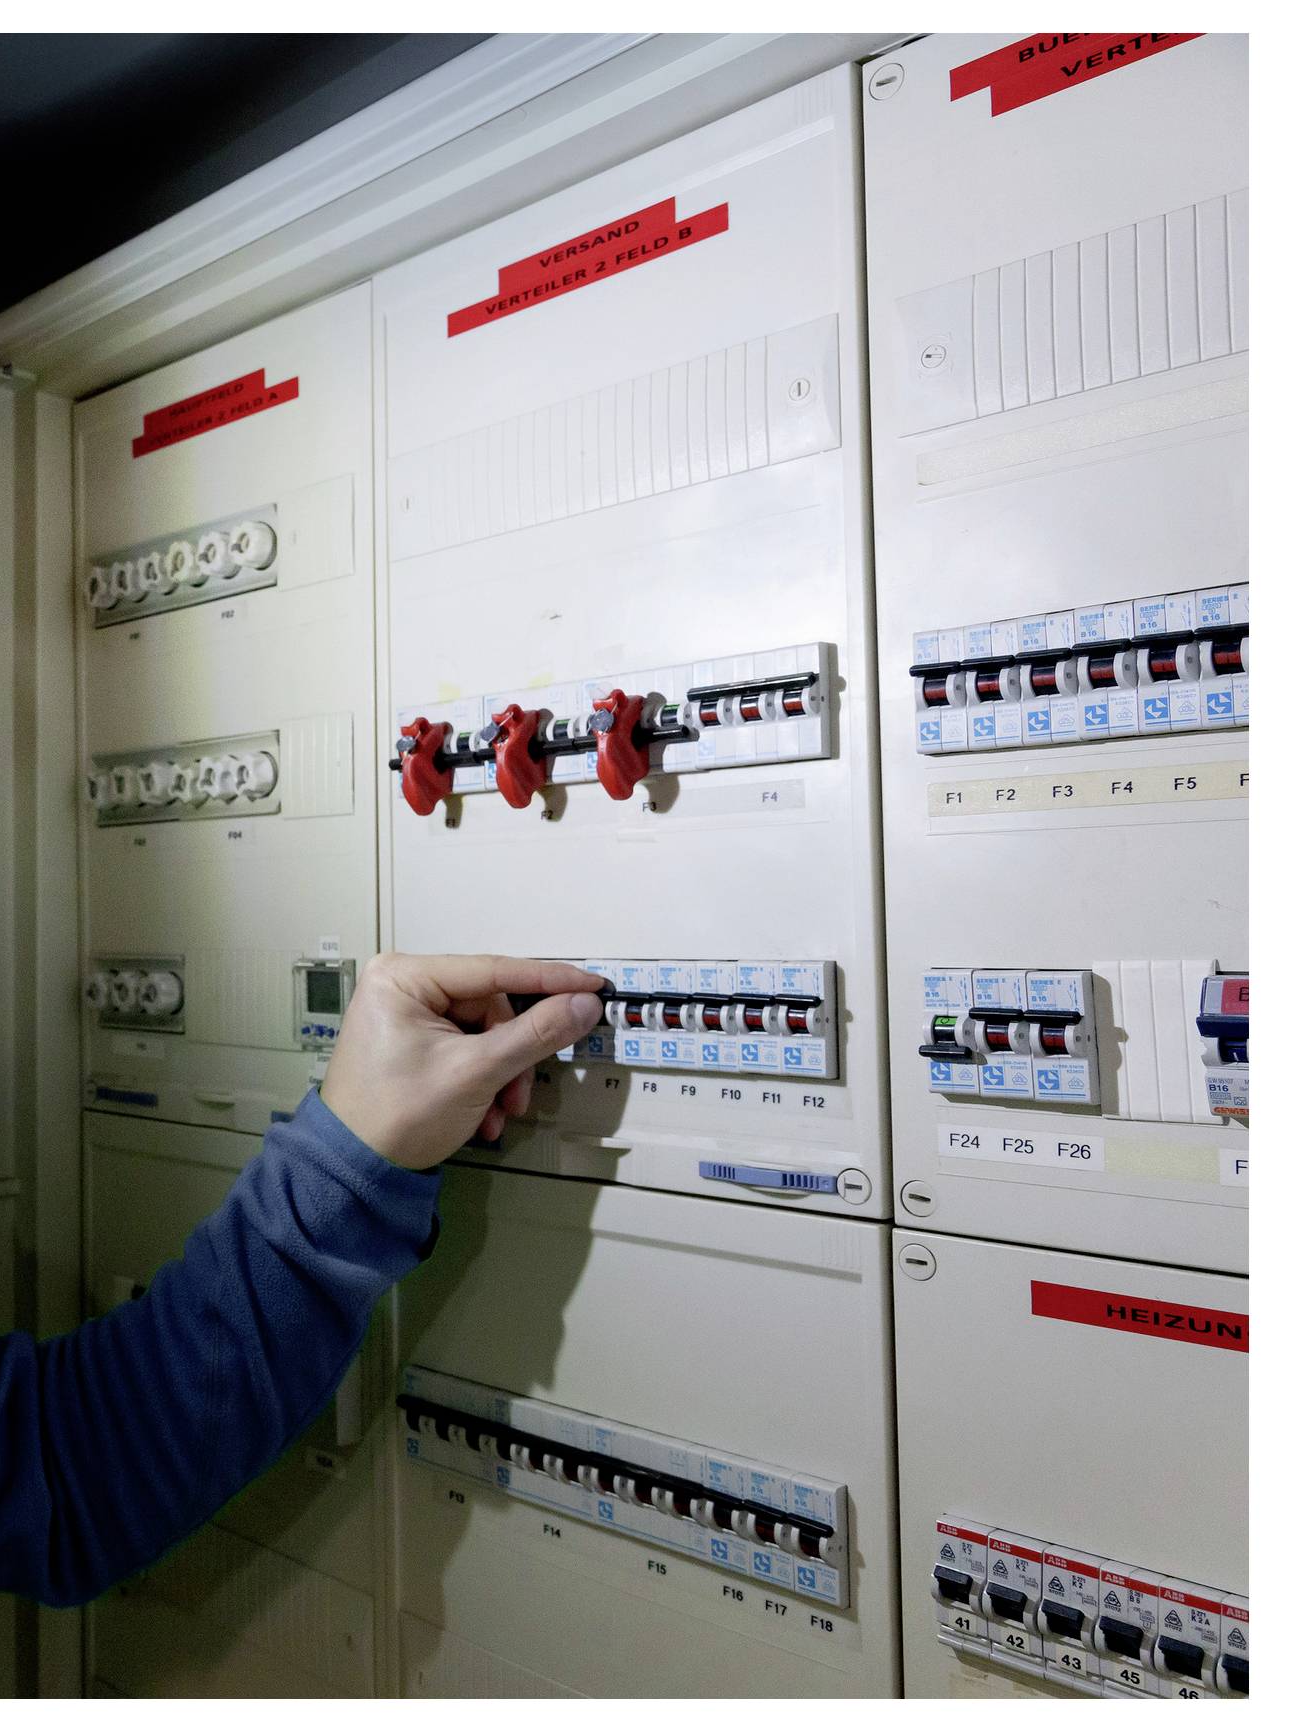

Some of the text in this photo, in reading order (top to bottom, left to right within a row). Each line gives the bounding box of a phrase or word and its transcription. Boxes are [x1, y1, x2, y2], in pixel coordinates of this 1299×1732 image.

[1019, 33, 1091, 63] BUE
[1061, 33, 1180, 77] VERTE
[539, 221, 640, 268] VERSAND
[485, 226, 693, 315] VERTEILER 2 FELD B
[762, 791, 778, 803] F4
[946, 792, 962, 804] F1
[996, 788, 1016, 801] F2
[1052, 785, 1073, 798] F3
[1111, 781, 1134, 794] F4
[1174, 776, 1197, 790] F5
[642, 801, 657, 812] F3
[605, 1078, 825, 1108] F7 F8 F9 F10 F11 F12
[949, 1133, 1091, 1160] F24 F25 F26
[1235, 1159, 1249, 1175] F
[1107, 1304, 1249, 1340] HEIZUN
[449, 1490, 465, 1504] F13
[543, 1524, 561, 1538] F14
[648, 1560, 667, 1576] F15
[1105, 1573, 1125, 1585] ABB
[1164, 1590, 1185, 1602] ABB
[723, 1585, 833, 1633] F16 F17 F18
[1227, 1607, 1249, 1620] ABB
[955, 1616, 970, 1630] 41
[1006, 1634, 1025, 1649] 42
[1061, 1654, 1081, 1670] 43
[1120, 1669, 1140, 1684] 45
[1178, 1687, 1200, 1699] 46
